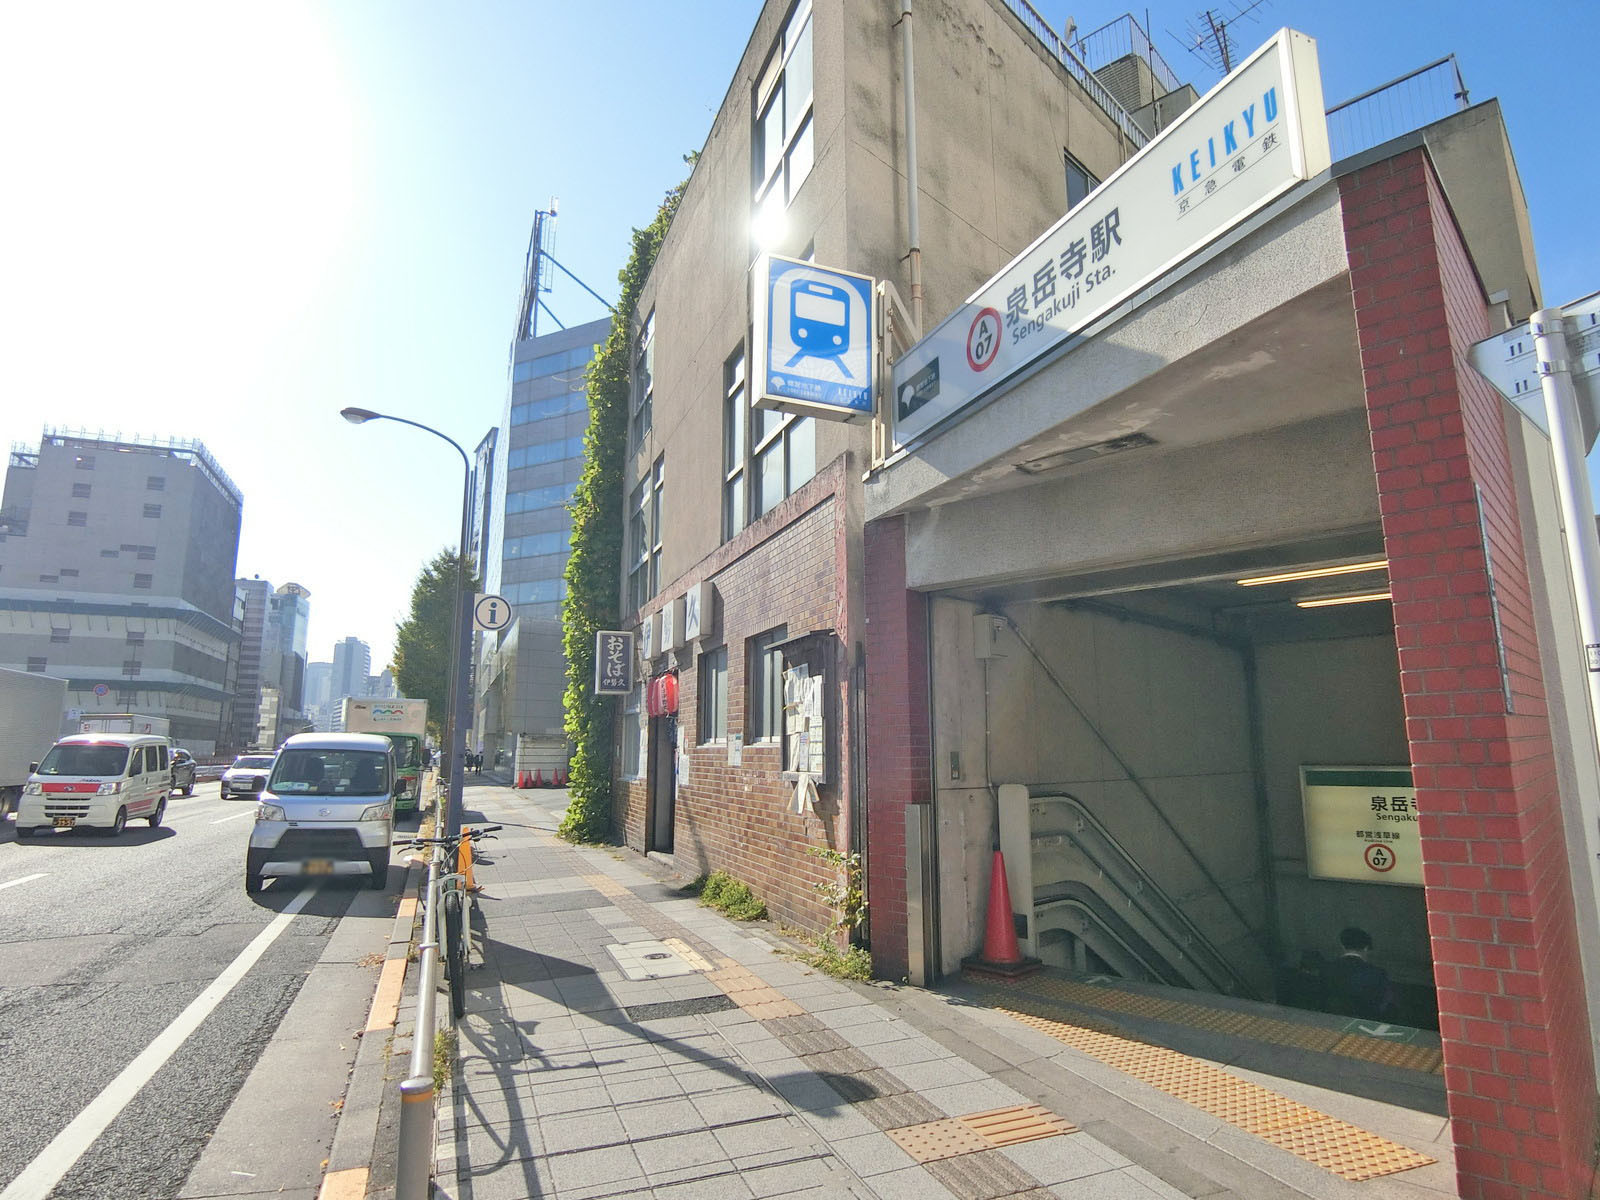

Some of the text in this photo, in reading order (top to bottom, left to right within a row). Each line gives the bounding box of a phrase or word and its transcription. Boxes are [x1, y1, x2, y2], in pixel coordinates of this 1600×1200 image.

[1171, 87, 1278, 196] KEIKYU
[1178, 132, 1278, 214] 京急電鉄
[1005, 207, 1123, 329] 泉岳寺駅
[1012, 265, 1117, 346] Sengakuji Sta.
[975, 333, 993, 360] 07
[979, 319, 989, 339] A
[607, 636, 625, 677] おそば
[1373, 857, 1387, 866] 07
[1375, 849, 1384, 857] A
